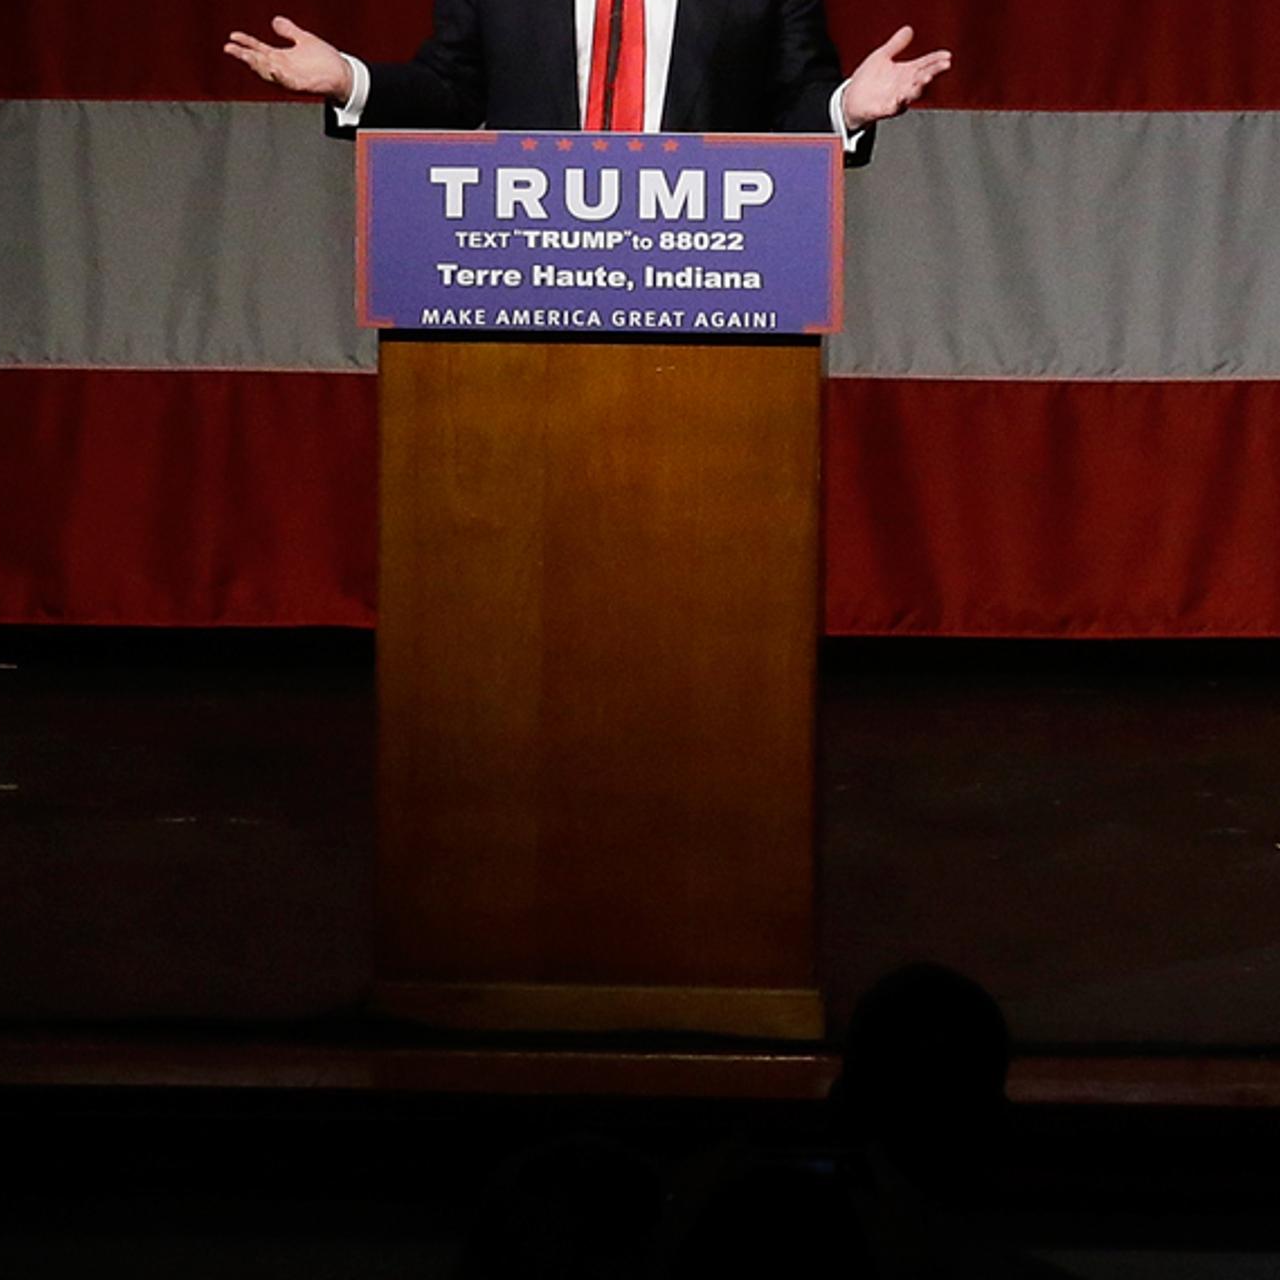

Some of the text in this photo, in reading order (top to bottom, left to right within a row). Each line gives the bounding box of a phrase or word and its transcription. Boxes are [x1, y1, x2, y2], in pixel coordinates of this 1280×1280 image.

[430, 167, 775, 222] TRUMP
[455, 231, 511, 248] TEXT
[632, 234, 653, 251] to
[659, 231, 744, 251] 88022
[436, 263, 761, 291] Terre Haute, Indiana
[422, 308, 777, 328] MAKE AMERICA GREAT AGAIN!
